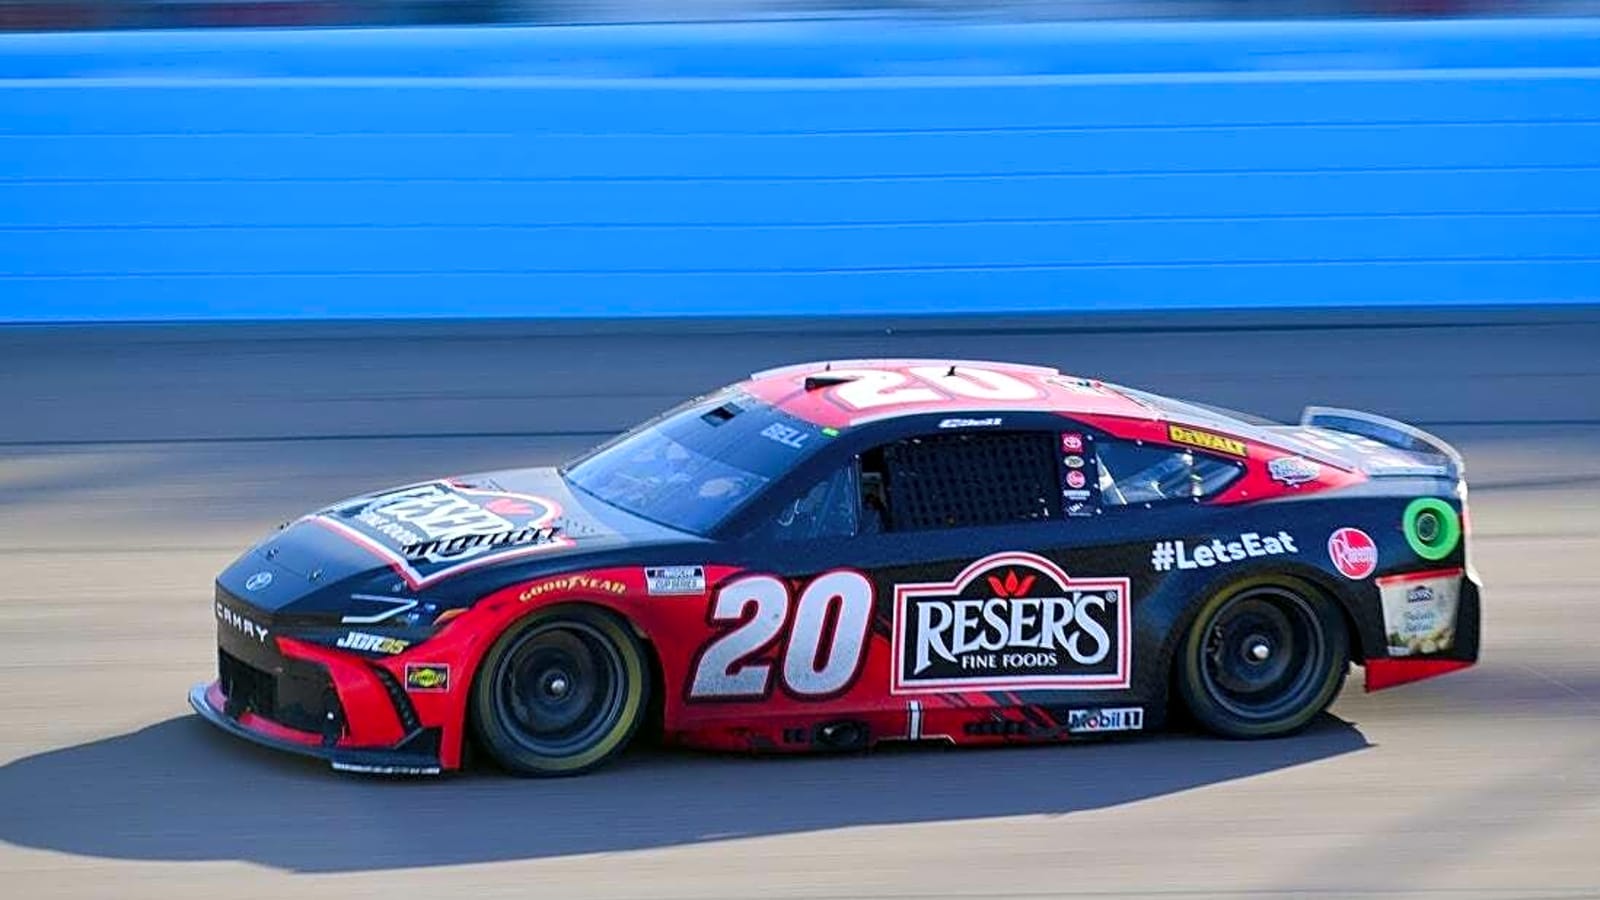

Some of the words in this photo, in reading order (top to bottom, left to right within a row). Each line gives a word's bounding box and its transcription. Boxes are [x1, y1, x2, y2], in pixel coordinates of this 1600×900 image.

[811, 365, 1040, 409] 20
[761, 422, 809, 449] BELL
[1151, 531, 1299, 572] #LetsEat
[519, 575, 627, 602] GOODYEAR
[216, 602, 269, 642] CAMRY
[690, 571, 873, 696] 20
[913, 591, 1110, 676] RESER'S
[961, 653, 998, 670] FINE
[1002, 651, 1059, 668] FOODS
[1071, 711, 1120, 730] Mobil
